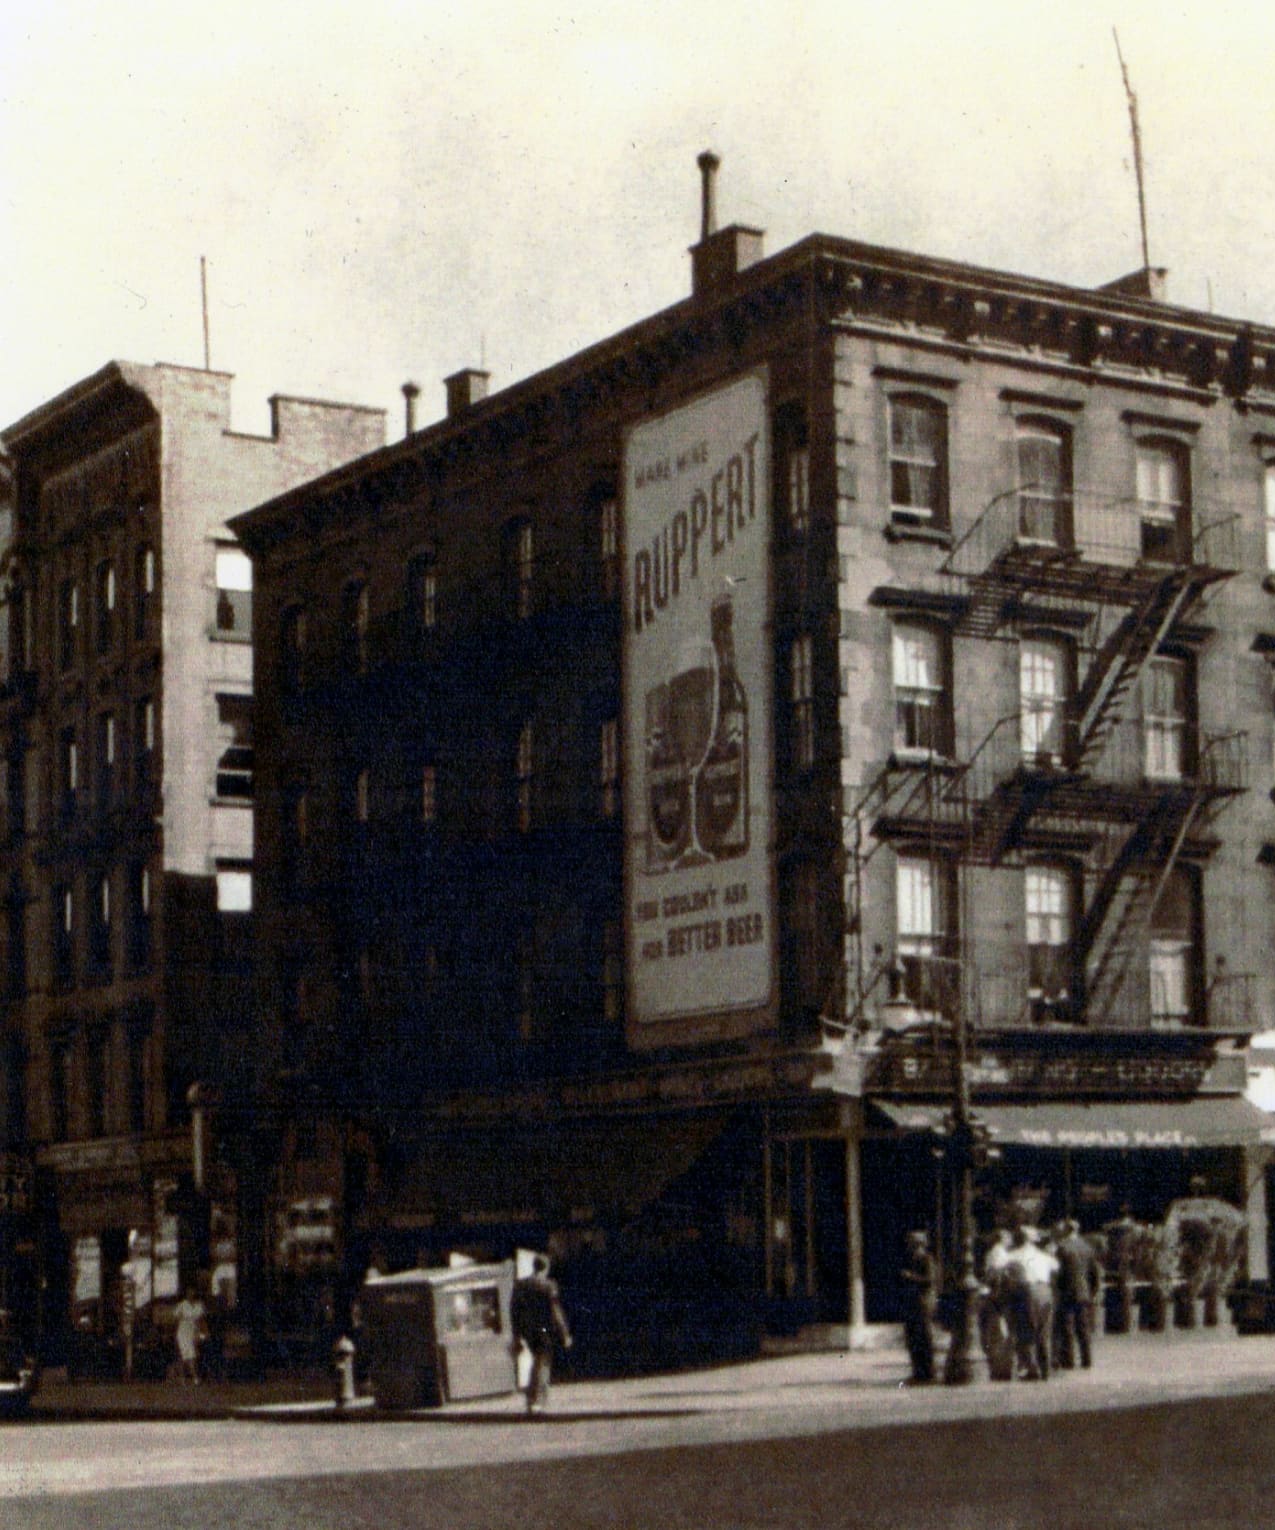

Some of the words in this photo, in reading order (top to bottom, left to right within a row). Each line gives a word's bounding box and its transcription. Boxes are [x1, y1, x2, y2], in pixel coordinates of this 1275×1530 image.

[634, 431, 760, 635] RUPPERT
[667, 920, 721, 957] BETTER
[726, 913, 764, 948] BEER
